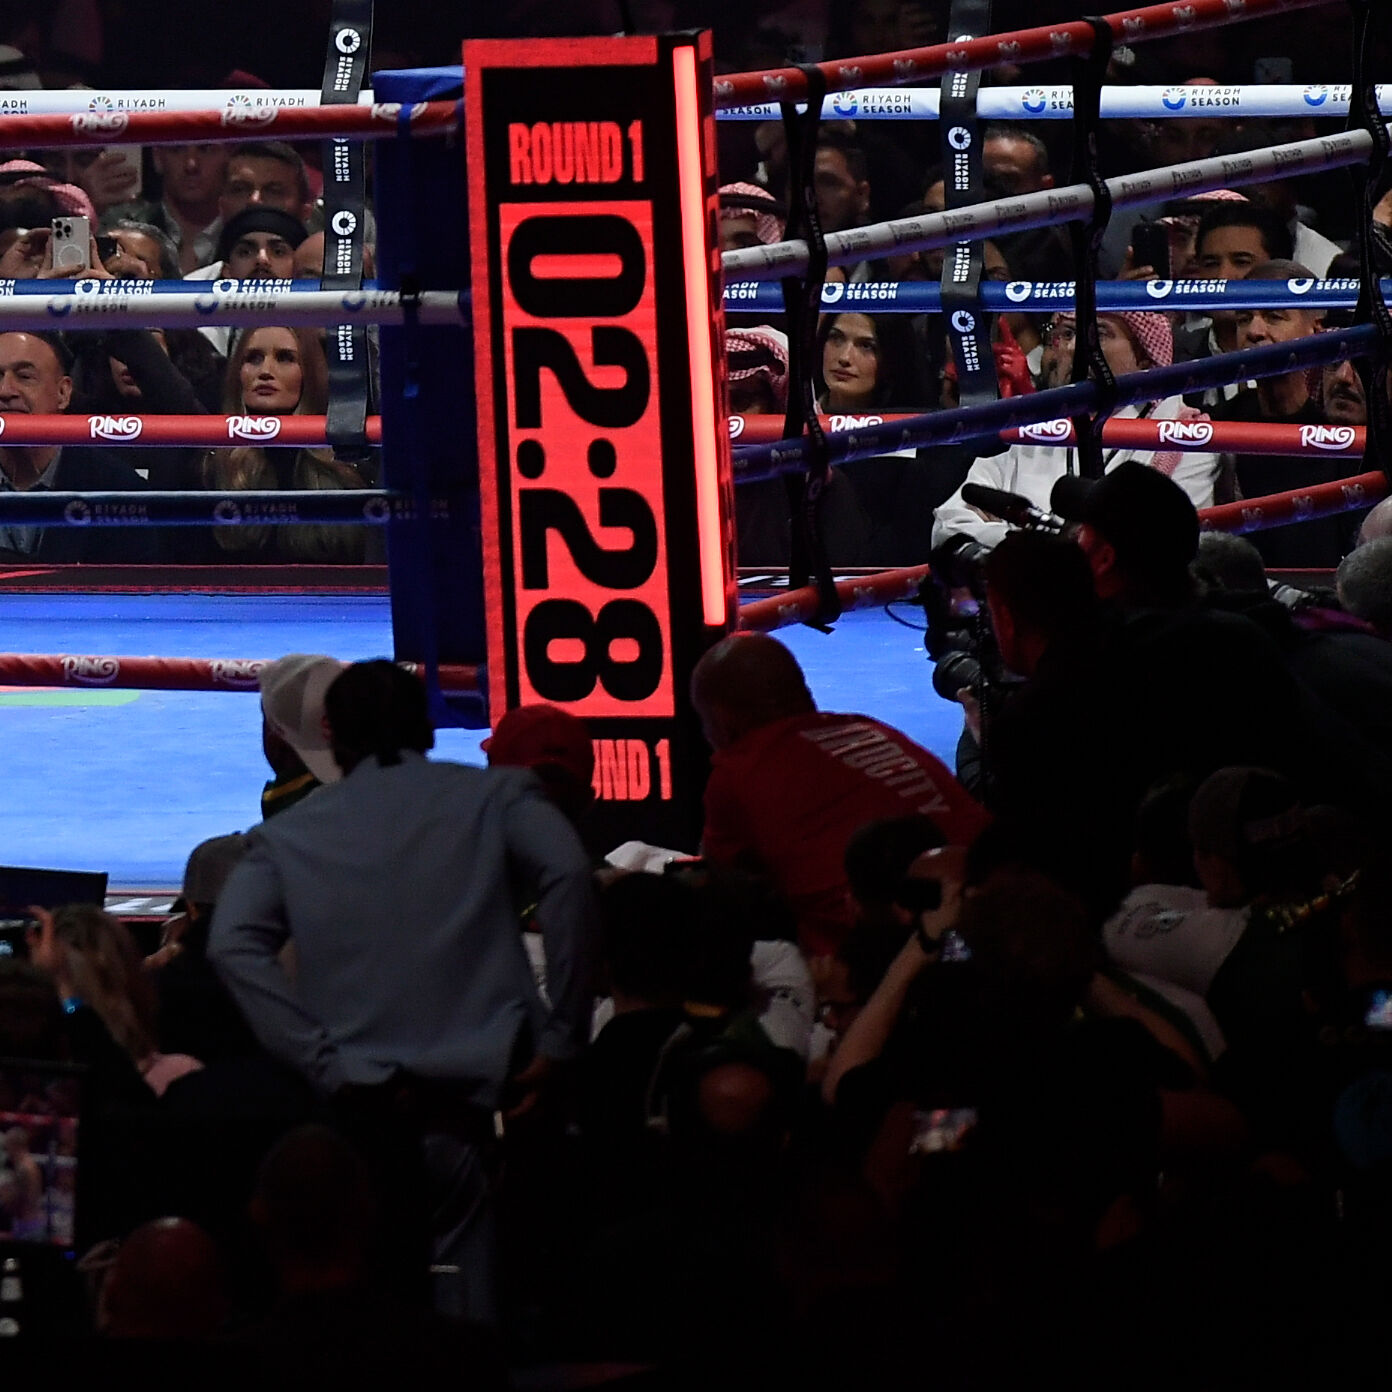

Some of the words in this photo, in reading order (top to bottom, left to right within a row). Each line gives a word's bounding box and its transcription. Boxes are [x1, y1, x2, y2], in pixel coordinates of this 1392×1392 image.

[334, 56, 346, 91] SEASON
[341, 57, 354, 91] RIYADH
[117, 98, 166, 107] RIYADH
[256, 97, 304, 106] RIYADH
[862, 94, 911, 104] RIYADH
[1191, 88, 1241, 96] RIYADH
[1191, 97, 1239, 106] SEASON
[722, 105, 772, 115] SEASON
[862, 104, 912, 114] SEASON
[335, 146, 344, 182] SEASON
[342, 146, 350, 182] RIYADH
[509, 121, 624, 185] ROUND
[627, 120, 644, 183] 1
[954, 154, 962, 190] SEASON
[961, 154, 969, 190] RIYADH
[337, 239, 345, 274] SEASON
[343, 239, 351, 274] RIYADH
[953, 247, 963, 282] SEASON
[961, 247, 970, 282] RIYADH
[103, 285, 152, 294] SEASON
[242, 285, 291, 294] SEASON
[847, 289, 897, 299] SEASON
[1175, 283, 1226, 293] SEASON
[88, 415, 142, 440] RING
[226, 415, 281, 441] RING
[1157, 421, 1213, 446] RING
[1299, 425, 1355, 450] RING
[507, 213, 664, 704] 02:28
[655, 738, 673, 800] 1
